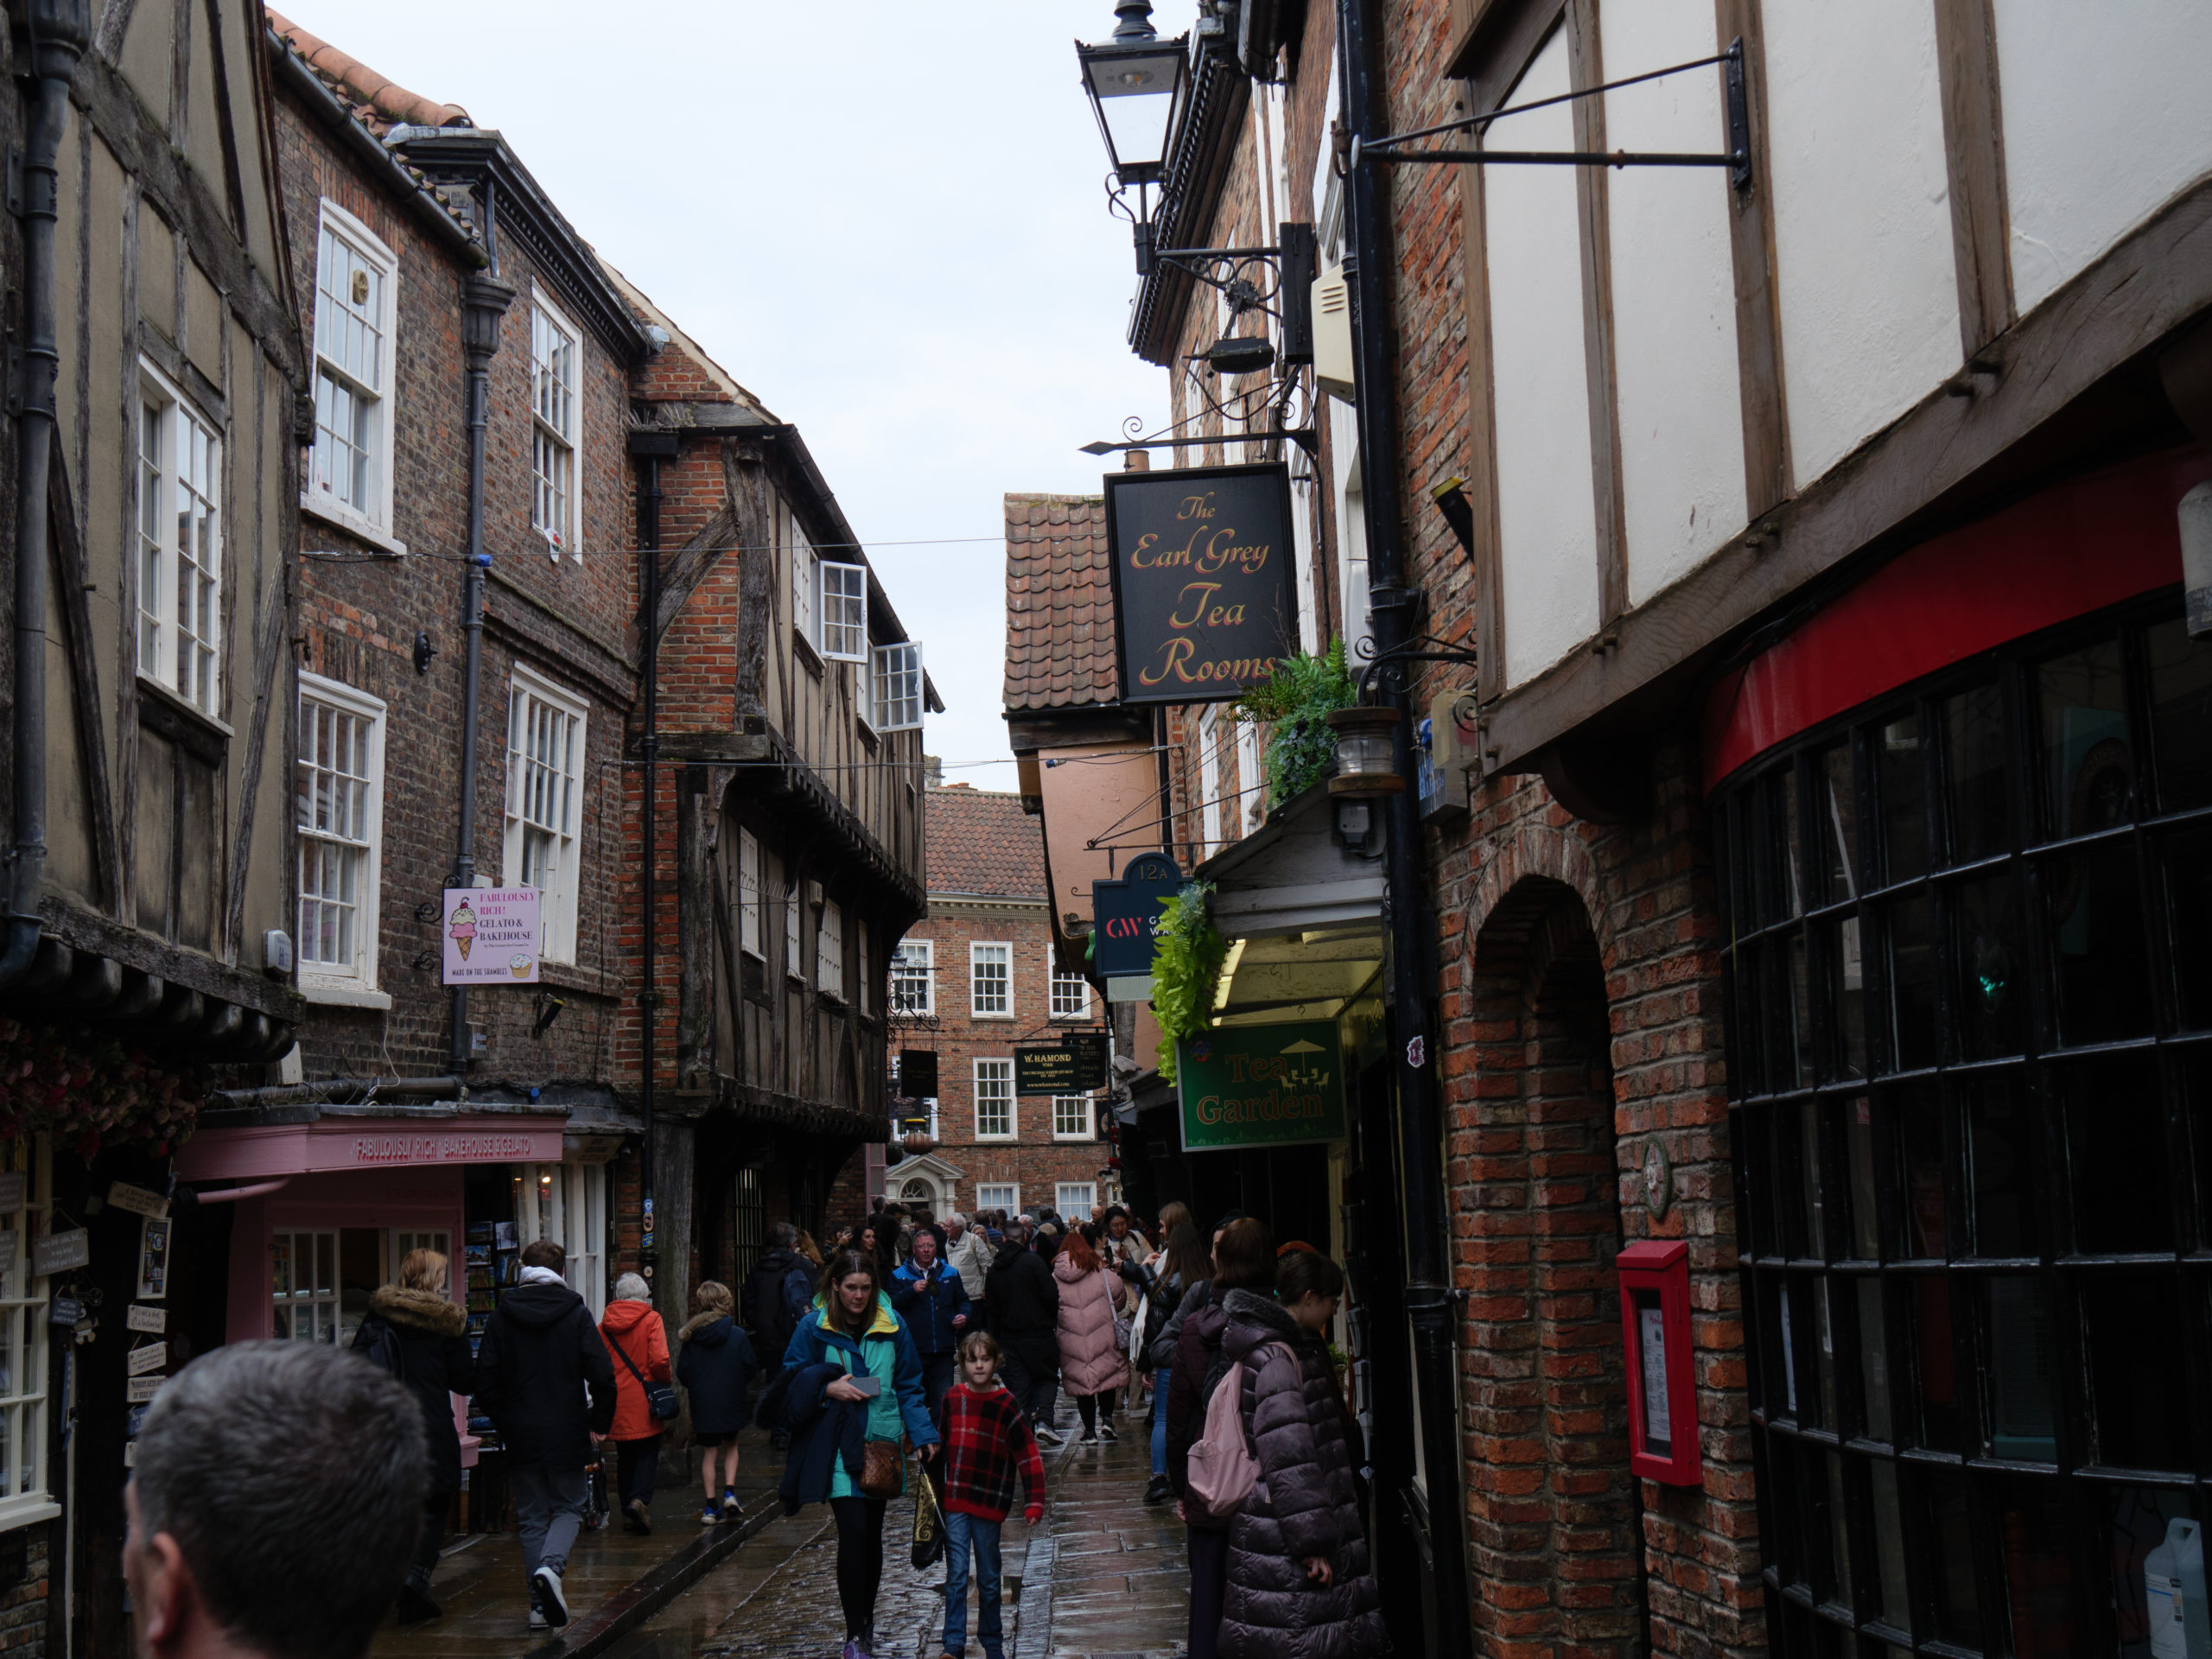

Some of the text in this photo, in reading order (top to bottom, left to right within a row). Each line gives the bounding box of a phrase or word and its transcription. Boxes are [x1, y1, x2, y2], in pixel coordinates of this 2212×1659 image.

[1176, 491, 1216, 520] The
[1130, 525, 1270, 574] Earl Grey
[1168, 582, 1246, 629] Tea
[1139, 635, 1276, 686] Rooms
[1140, 864, 1169, 880] 12A
[480, 892, 535, 902] FABULOUSLY
[480, 906, 505, 915] RICH!
[480, 918, 523, 928] GELATO &
[1106, 917, 1142, 938] GW
[480, 931, 533, 941] BAKEHOUSE
[484, 967, 507, 976] SHAMBLES
[1224, 1052, 1289, 1084] Tea
[1197, 1088, 1325, 1125] Garden
[358, 1135, 531, 1161] FABULOUSLY RICH BAKEHOUSE & GELATO
